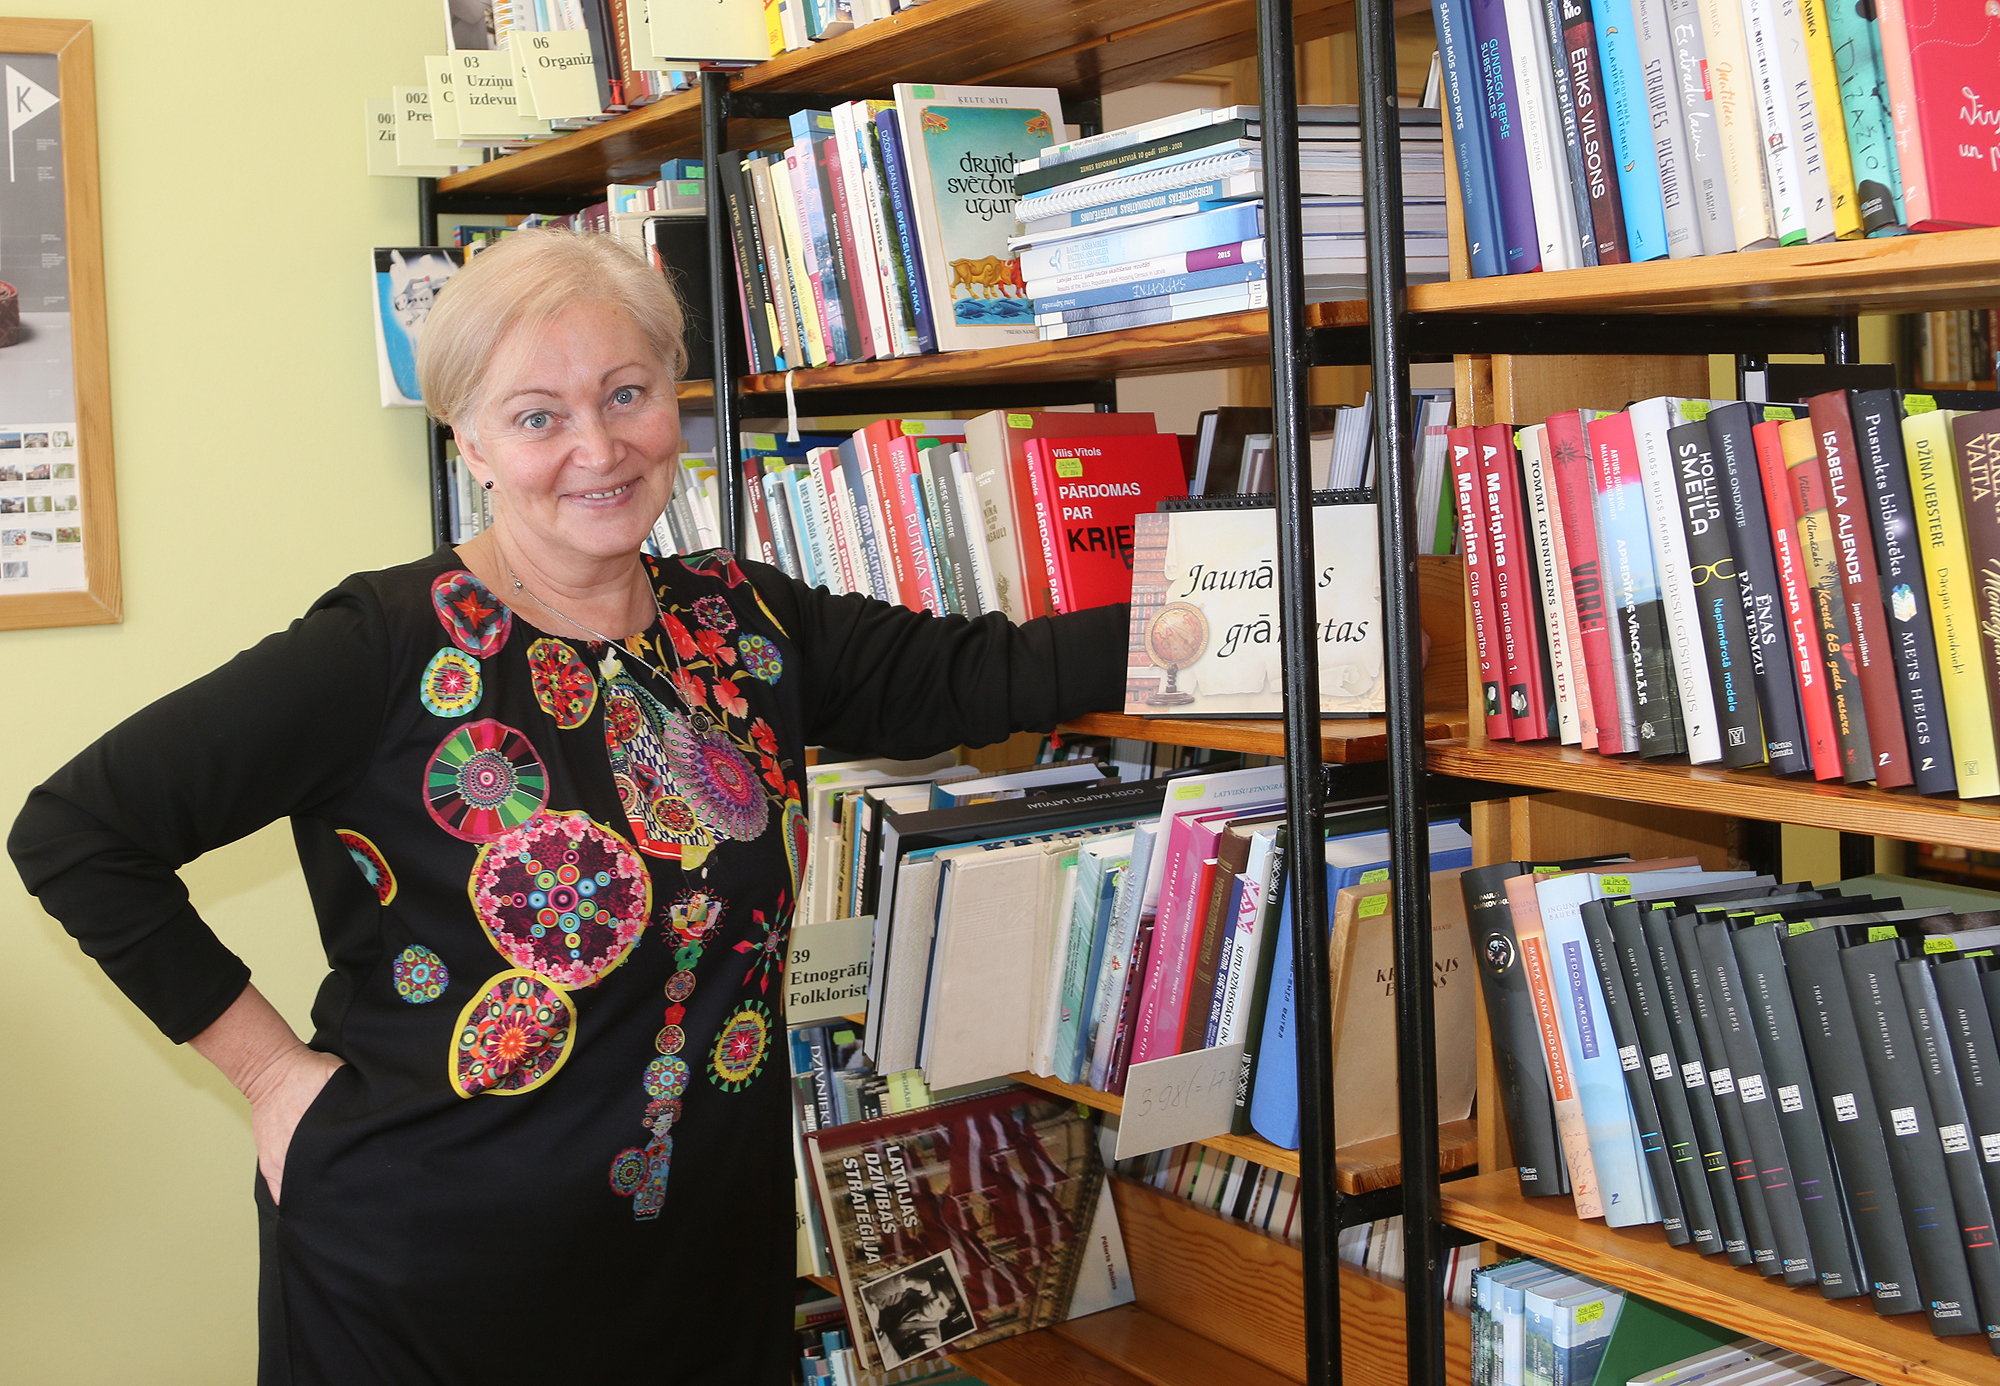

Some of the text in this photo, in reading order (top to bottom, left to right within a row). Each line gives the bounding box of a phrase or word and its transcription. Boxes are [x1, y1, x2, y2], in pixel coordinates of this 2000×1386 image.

[464, 56, 479, 68] 03
[532, 36, 549, 51] 06
[538, 54, 594, 69] Organiz
[1440, 2, 1465, 131] SĀKUMS MŪS ATROD PATS
[1674, 23, 1695, 46] Es
[16, 86, 32, 112] K
[405, 93, 427, 104] 002
[467, 74, 512, 90] Uzziņu
[1480, 42, 1497, 120] SUBSTANCES
[1489, 38, 1511, 140] GUNDEGA REPŠE
[1677, 50, 1699, 107] atradu
[1520, 55, 1543, 173] Silvija Brice PIEZĪMES
[1571, 48, 1606, 200] ĒRIKS VILSONS
[1645, 59, 1680, 210] STRAUPES PILSKUNGI
[1688, 112, 1711, 162] laimi
[1795, 79, 1821, 175] KLĀTBŪTNE
[960, 151, 1025, 174] druīd
[1460, 143, 1473, 205] Kārlis Kozāks
[880, 129, 921, 315] DŽONS BANJANS SVĒTCEĻNIEKA TAKA
[1217, 250, 1231, 260] 2015
[896, 448, 907, 475] ANNA
[1052, 447, 1102, 458] Vilis Vītols
[1599, 443, 1611, 477] MALHAZS
[1610, 449, 1625, 511] ARTURS JURKEVIČS
[1699, 451, 1721, 520] HOLLIJA
[1722, 433, 1747, 529] MAIKLS ONDATJE
[1965, 433, 1993, 502] VAITA
[799, 481, 818, 541] NEVIENAM
[812, 456, 830, 523] REFORMA
[828, 493, 844, 545] Latvietis
[857, 504, 871, 536] ANNA
[938, 475, 956, 540] INESE VAIDERE
[1058, 482, 1142, 500] PĀRDOMAS
[1062, 506, 1094, 521] PAR
[1679, 442, 1710, 536] SMEILA
[1822, 430, 1863, 586] ISABELLA ALJENDE
[1865, 413, 1906, 578] Pusnakts bibliotēka
[1916, 439, 1946, 549] DŽĪNA VEBSTERE
[883, 498, 905, 583] Mans stāsts
[904, 511, 924, 581] PUTINA
[1026, 451, 1060, 605] Vilis Vītols PĀRDOMAS PAR
[1066, 524, 1135, 559] KRIE
[1453, 445, 1490, 675] A. Mariņina Cita patiesība 2.
[1482, 445, 1518, 675] A. Mariņina Cita patiesība 1.
[953, 561, 964, 590] MISIJA
[1180, 560, 1335, 598] Jaunās
[1531, 459, 1568, 704] TOMMI KINNUNENS STIKLA UPE
[1645, 431, 1698, 713] KARLOSS RUISS SAFONS DEBESU GŪSTEKNIS
[1737, 569, 1766, 676] PĀR TEMZU
[1755, 593, 1777, 645] ĒNAS
[1627, 613, 1649, 706] VĪNOGULĀJS
[1713, 597, 1739, 713] Nepiemērotā modele
[1793, 618, 1814, 687] LAPSA
[1818, 586, 1850, 736] Karstā 68. gada vasara
[1901, 631, 1931, 746] METS HEIGS
[1026, 787, 1145, 811] GODS KALPOT LATVIJAI
[1213, 782, 1287, 799] LATVIEŠU ETNOGRA
[1150, 851, 1181, 991] Labas uzvedības grāmata
[790, 962, 870, 986] Etnogrāfi
[791, 950, 810, 965] 39
[1568, 946, 1583, 992] PIEDOD,
[1594, 938, 1617, 1006] OSVALDS ZEBRIS
[1627, 947, 1650, 1017] GUNTIS BERELIS
[1657, 946, 1683, 1026] PAULS BANKOVSKIS
[1867, 972, 1882, 1006] ANDRIS
[789, 984, 868, 1007] Folklorist
[1220, 944, 1246, 1043] SUITU DZĪVESSTĀSTI UN
[1527, 945, 1565, 1091] MARTA, MANA ANDROMEDA
[1689, 968, 1709, 1019] INGA GAILE
[1717, 965, 1741, 1034] GUNDEGA REPŠE
[1812, 984, 1824, 1006] INGA
[1918, 1007, 1942, 1076] NORA IKSTENA
[1957, 1007, 1985, 1089] ANDRA MANFELDE
[842, 1157, 881, 1266] STRATĒĢIJA
[863, 1151, 897, 1235] DZĪVĪBAS
[885, 1145, 918, 1229] LATVIJAS
[1100, 1235, 1118, 1291] Pēteris Tabūns
[1471, 1288, 1478, 1298] 5
[1494, 1301, 1502, 1311] 4
[1507, 1306, 1512, 1316] 1
[1534, 1313, 1541, 1324] 3
[1554, 1325, 1562, 1336] 2
